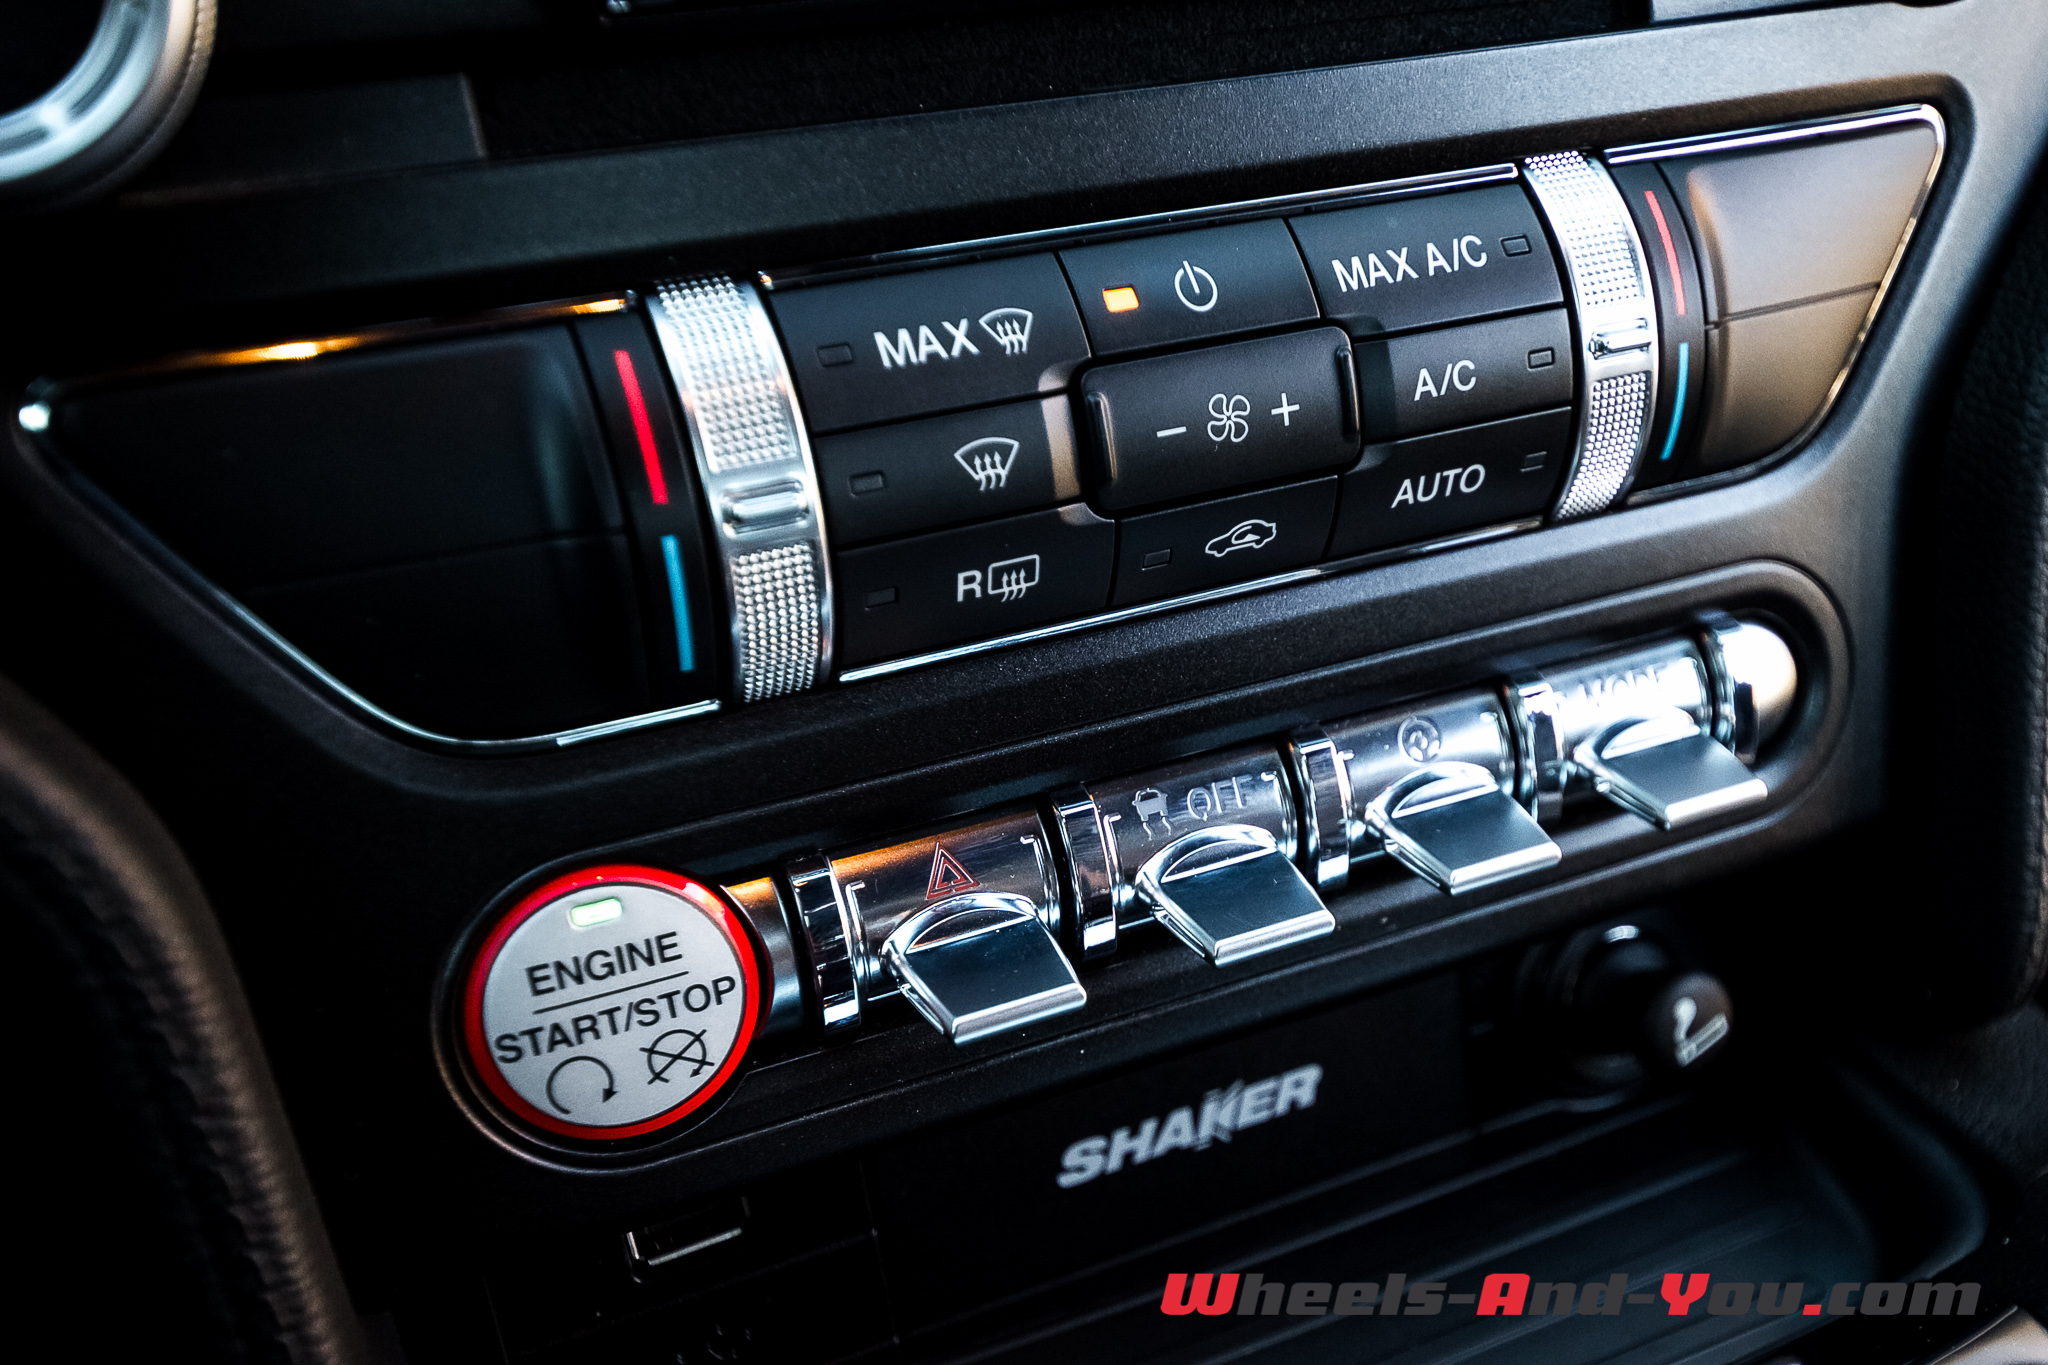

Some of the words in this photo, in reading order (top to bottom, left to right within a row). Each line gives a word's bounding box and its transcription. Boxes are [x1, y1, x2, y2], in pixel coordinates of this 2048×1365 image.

[1333, 246, 1418, 293] MAX
[1428, 234, 1488, 278] A/C
[873, 318, 980, 369] MAX
[1413, 360, 1478, 402] A/C
[1391, 463, 1486, 509] AUTO
[957, 568, 983, 603] R
[1187, 774, 1253, 822] OFF
[525, 931, 683, 997] ENGINE
[494, 975, 737, 1063] START/STOP
[1057, 1063, 1323, 1188] SHAKER
